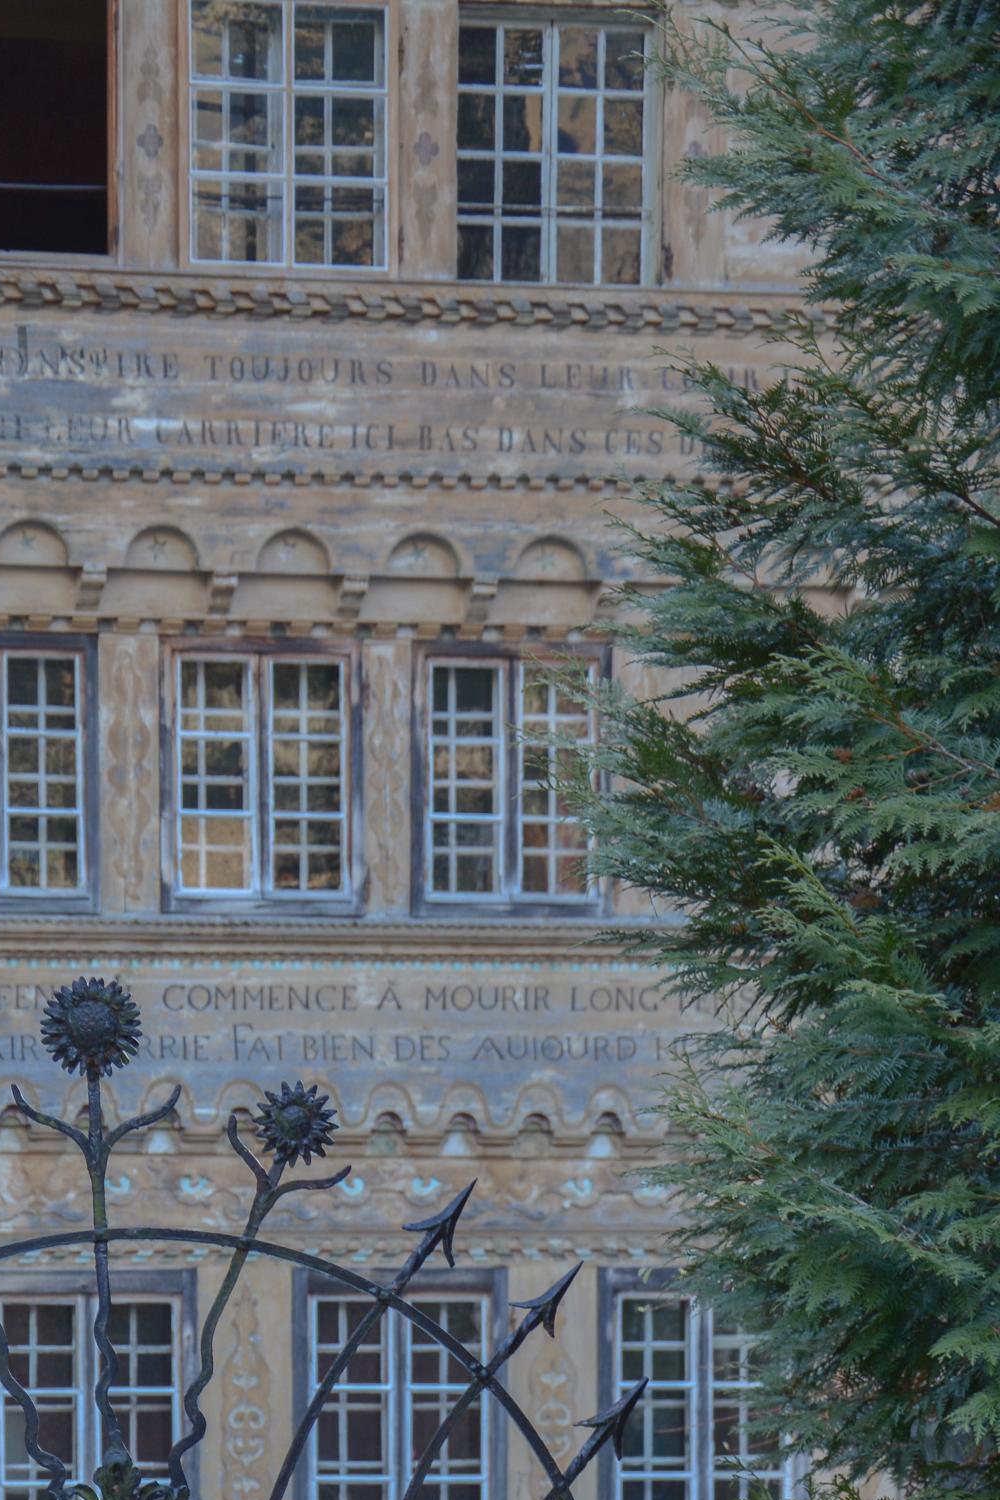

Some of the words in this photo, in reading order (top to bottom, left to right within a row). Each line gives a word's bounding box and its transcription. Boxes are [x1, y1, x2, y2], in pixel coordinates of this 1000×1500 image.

[203, 353, 395, 386] TOUJOURS
[420, 359, 517, 389] DANS
[350, 423, 396, 451] ICI
[418, 424, 479, 452] BAS
[496, 424, 588, 455] DANS
[604, 428, 664, 456] CES
[161, 982, 359, 1013] COMMENCE
[424, 984, 551, 1013] MOURIR
[569, 985, 659, 1013] LONG
[302, 1034, 375, 1063] BIEN
